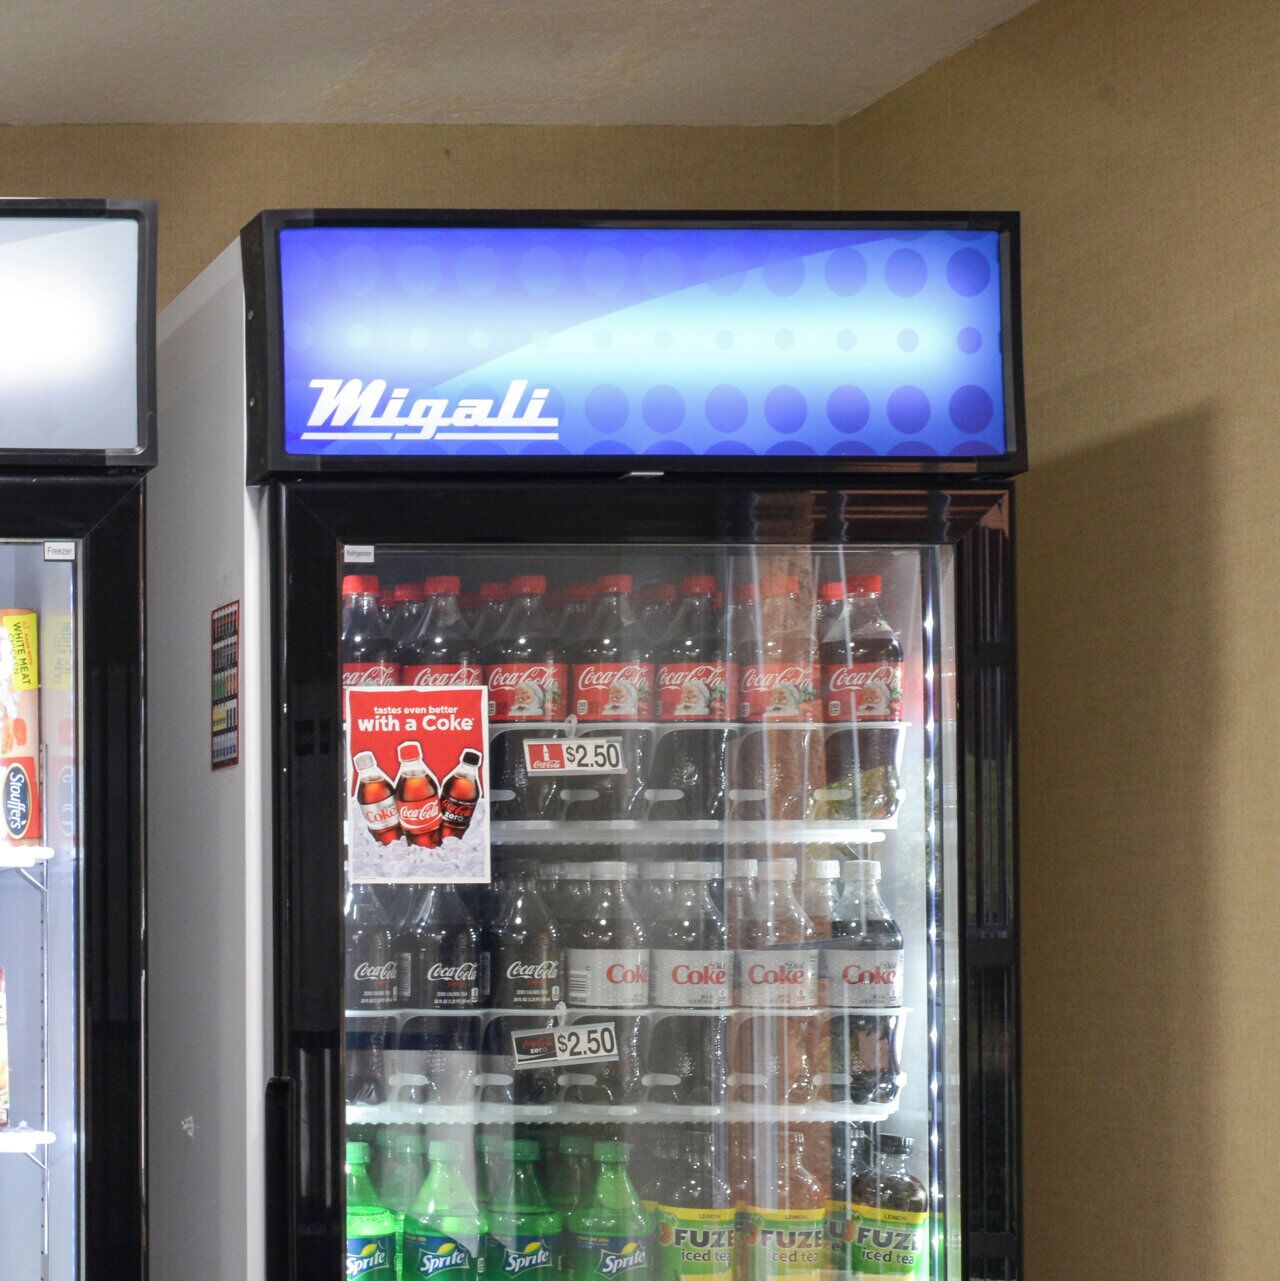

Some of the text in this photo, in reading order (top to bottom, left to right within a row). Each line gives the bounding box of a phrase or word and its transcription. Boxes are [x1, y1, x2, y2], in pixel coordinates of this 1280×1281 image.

[308, 379, 559, 440] Migali
[12, 622, 32, 685] WHITE MEAT
[374, 706, 402, 714] tastes
[428, 706, 458, 714] better
[358, 715, 473, 731] with a Coke
[566, 743, 620, 769] $2.50
[9, 772, 27, 829] Stouffer's
[400, 800, 438, 819] Coca-Cola
[366, 804, 397, 823] Coke
[445, 810, 464, 822] zero
[427, 962, 477, 981] Coca-Cola
[507, 961, 558, 980] Coca-Cola
[672, 964, 726, 984] Coke
[748, 964, 804, 984] Coke
[842, 964, 896, 984] Coke
[558, 1027, 615, 1056] $2.50
[674, 1228, 736, 1249] FUZE
[346, 1250, 385, 1273] Sprite
[420, 1250, 465, 1272] Sprite
[505, 1249, 550, 1272] Sprite
[601, 1251, 646, 1272] Sprite
[682, 1249, 731, 1262] iced tea
[768, 1250, 818, 1262] iced tea
[861, 1250, 914, 1264] iced tea
